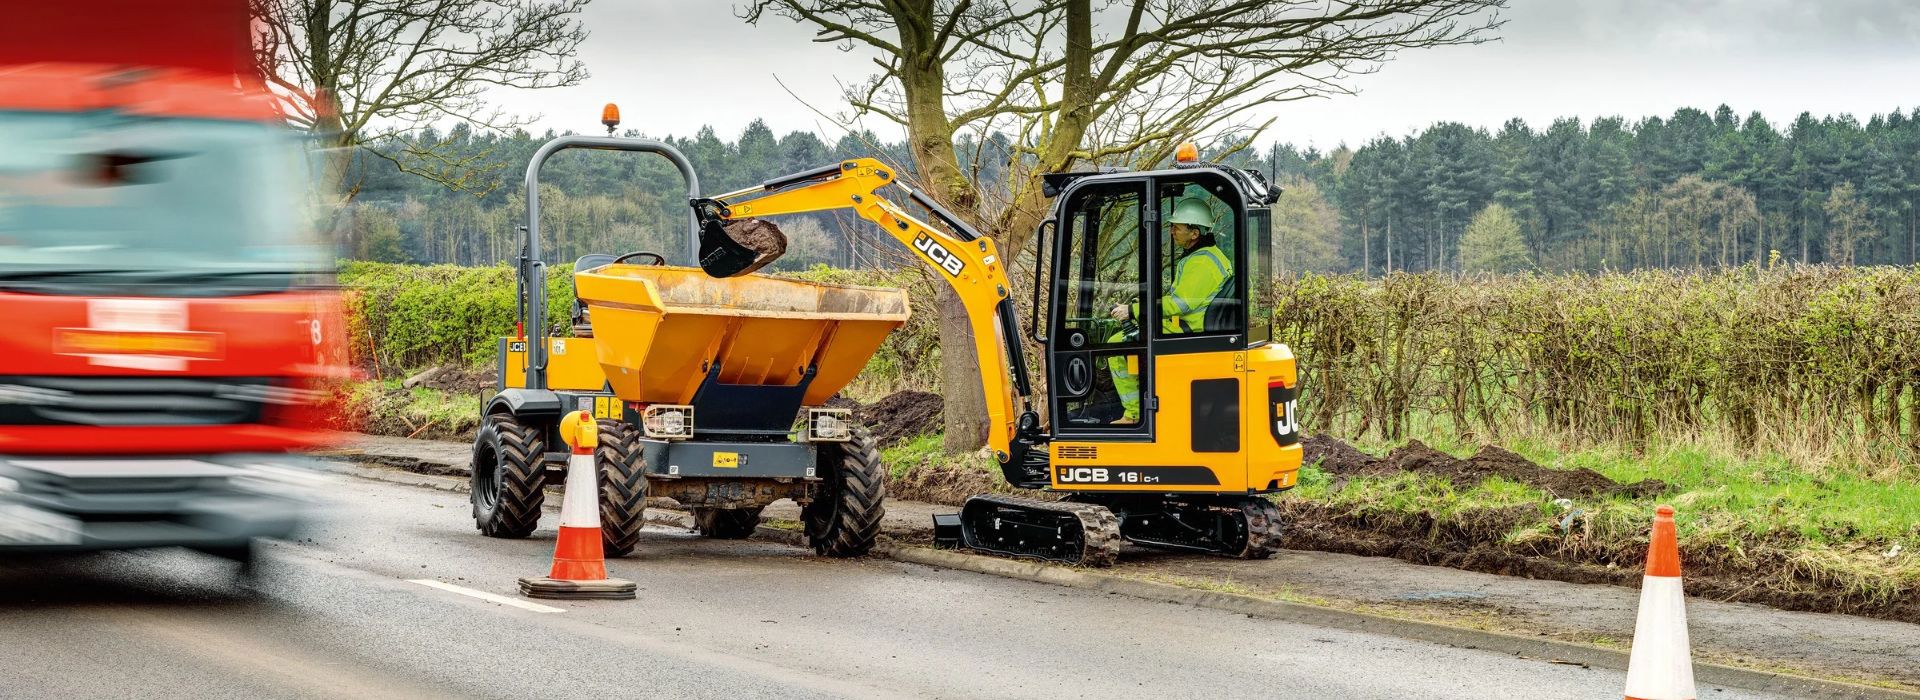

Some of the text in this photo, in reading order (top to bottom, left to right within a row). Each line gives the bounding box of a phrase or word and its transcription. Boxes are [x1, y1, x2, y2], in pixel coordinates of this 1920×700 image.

[914, 232, 963, 276] JCB
[1060, 468, 1109, 482] JCB
[1118, 472, 1138, 483] 16
